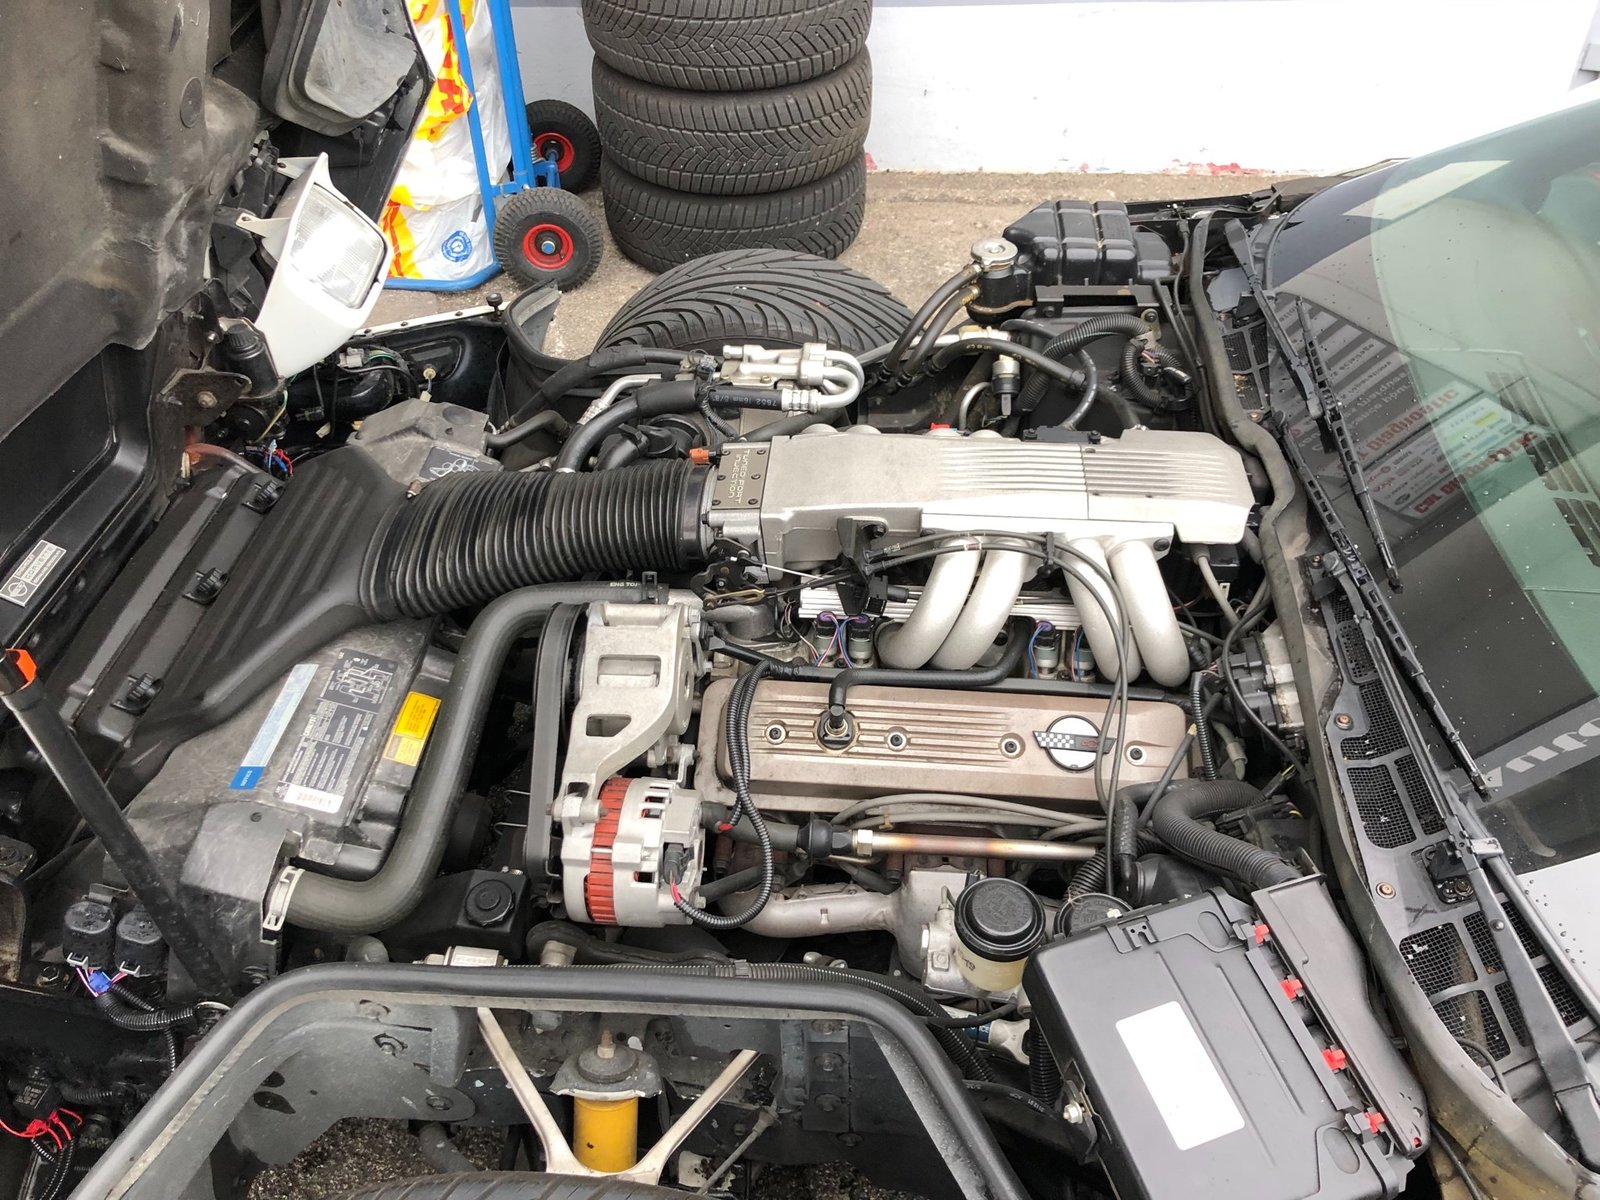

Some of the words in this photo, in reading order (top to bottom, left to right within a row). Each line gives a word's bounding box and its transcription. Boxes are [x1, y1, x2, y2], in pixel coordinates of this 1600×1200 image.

[728, 454, 742, 499] INJECTION
[739, 448, 750, 477] TUNED
[734, 479, 745, 504] PORT
[24, 544, 57, 580] CORVETTE
